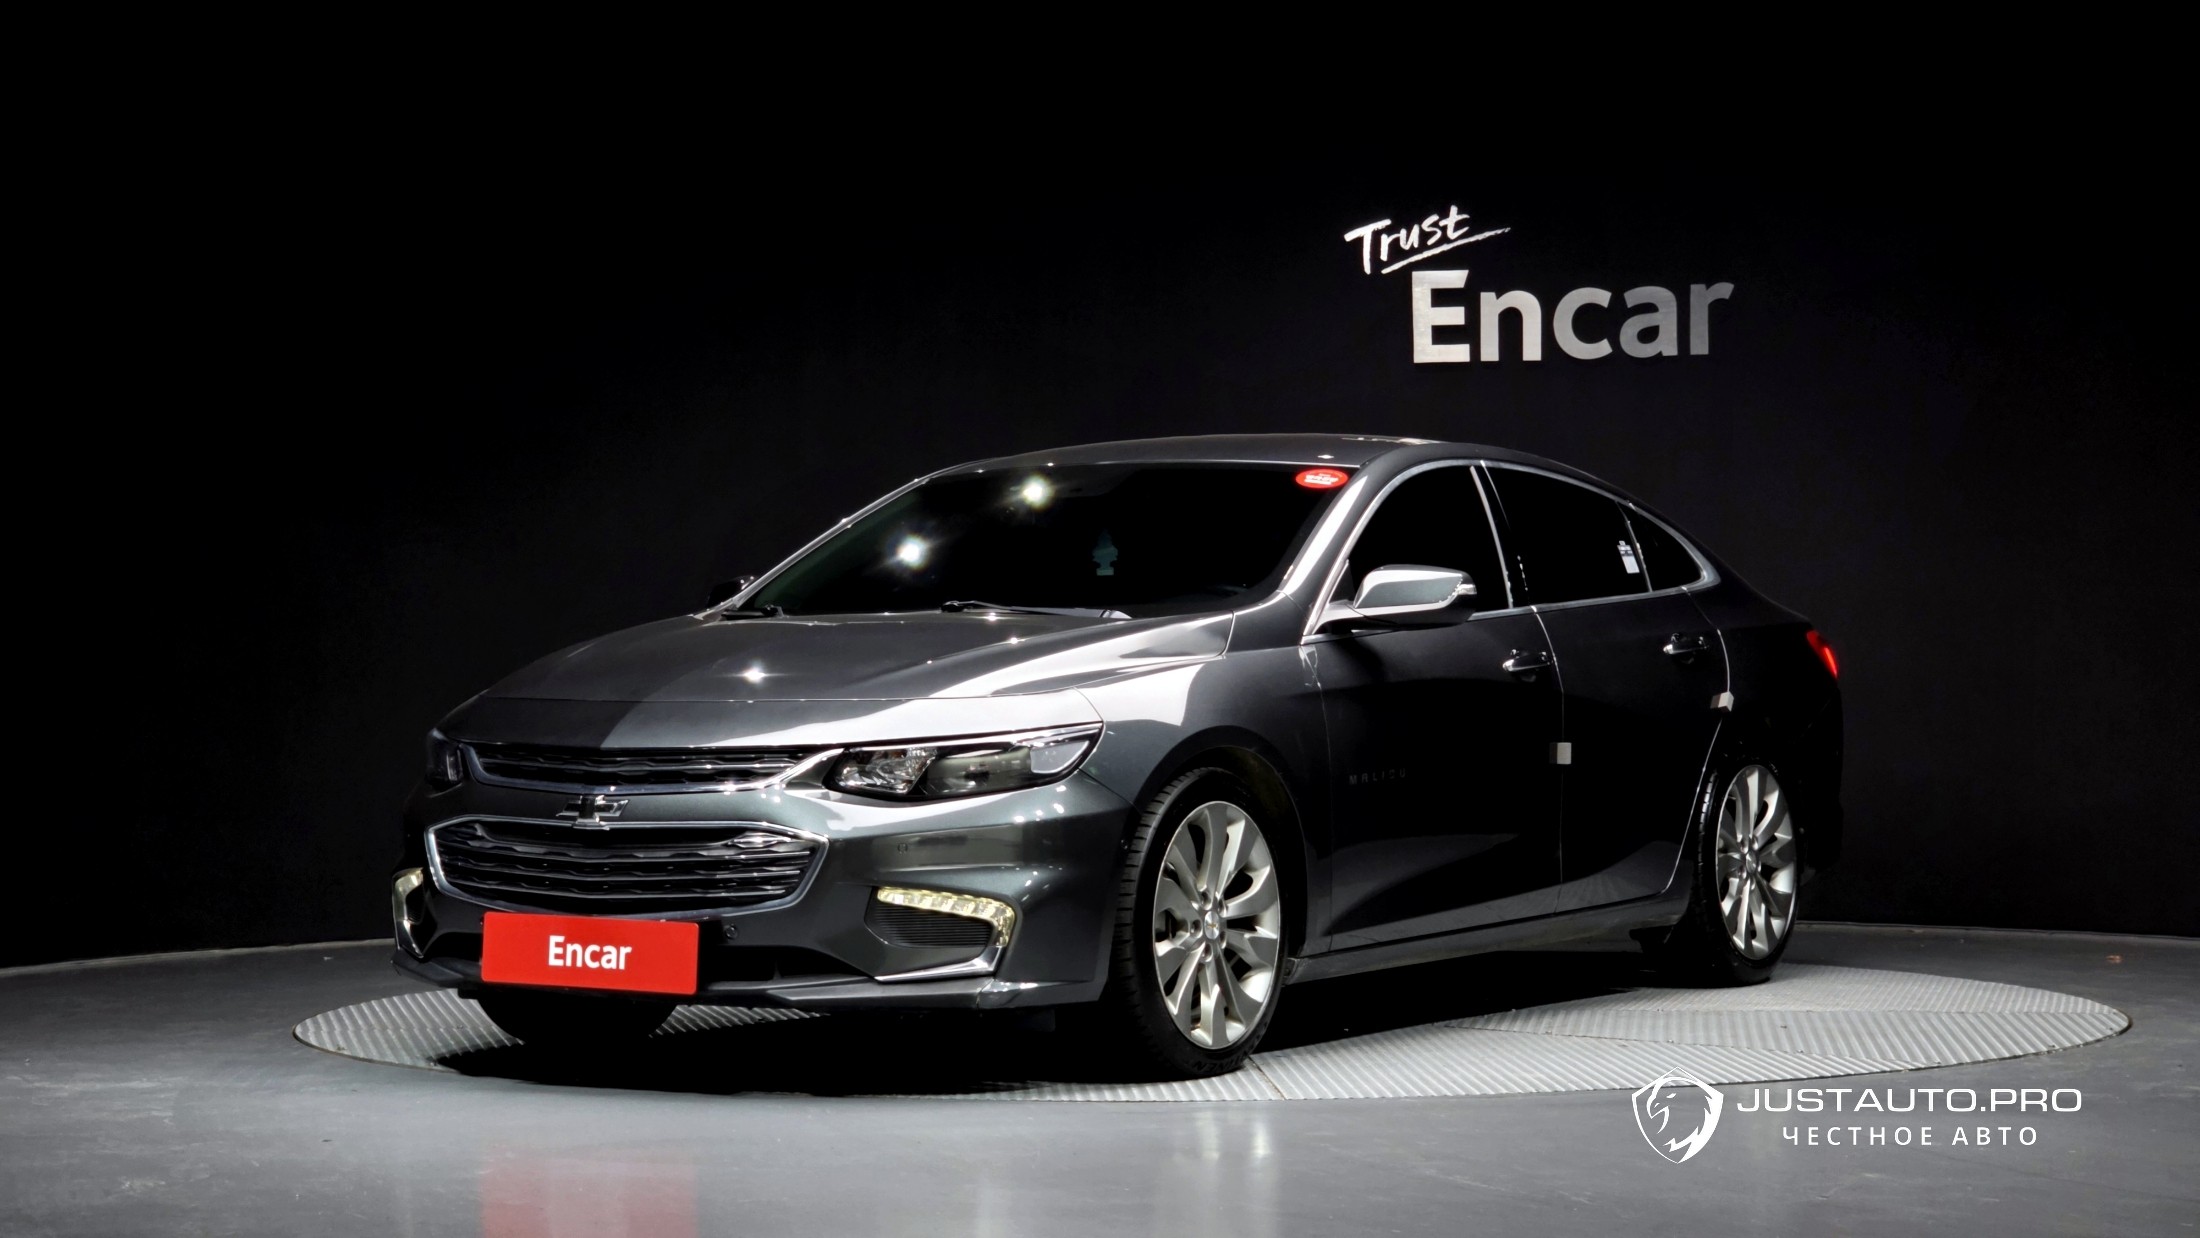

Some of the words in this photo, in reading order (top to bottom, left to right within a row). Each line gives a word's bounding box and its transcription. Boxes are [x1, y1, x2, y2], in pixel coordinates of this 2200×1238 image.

[1343, 204, 1471, 275] Trust
[1411, 269, 1735, 364] Encar
[548, 934, 633, 970] Encar
